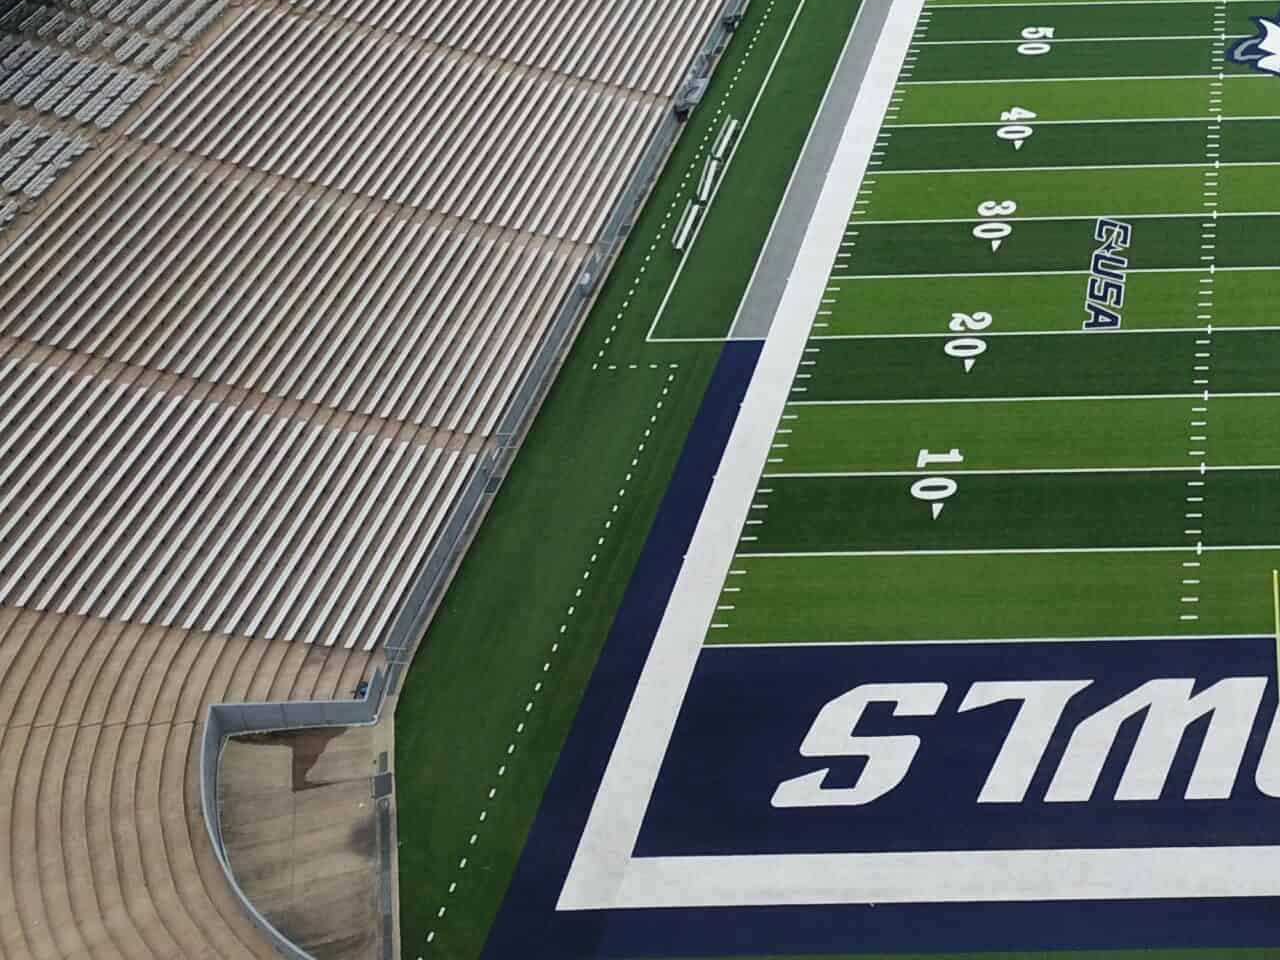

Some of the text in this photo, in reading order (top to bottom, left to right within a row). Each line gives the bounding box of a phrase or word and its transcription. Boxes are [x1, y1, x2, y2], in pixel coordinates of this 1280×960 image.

[1017, 26, 1055, 55] 50
[997, 107, 1037, 139] 40
[973, 200, 1017, 239] 30
[944, 311, 993, 357] 20
[910, 448, 964, 500] 10
